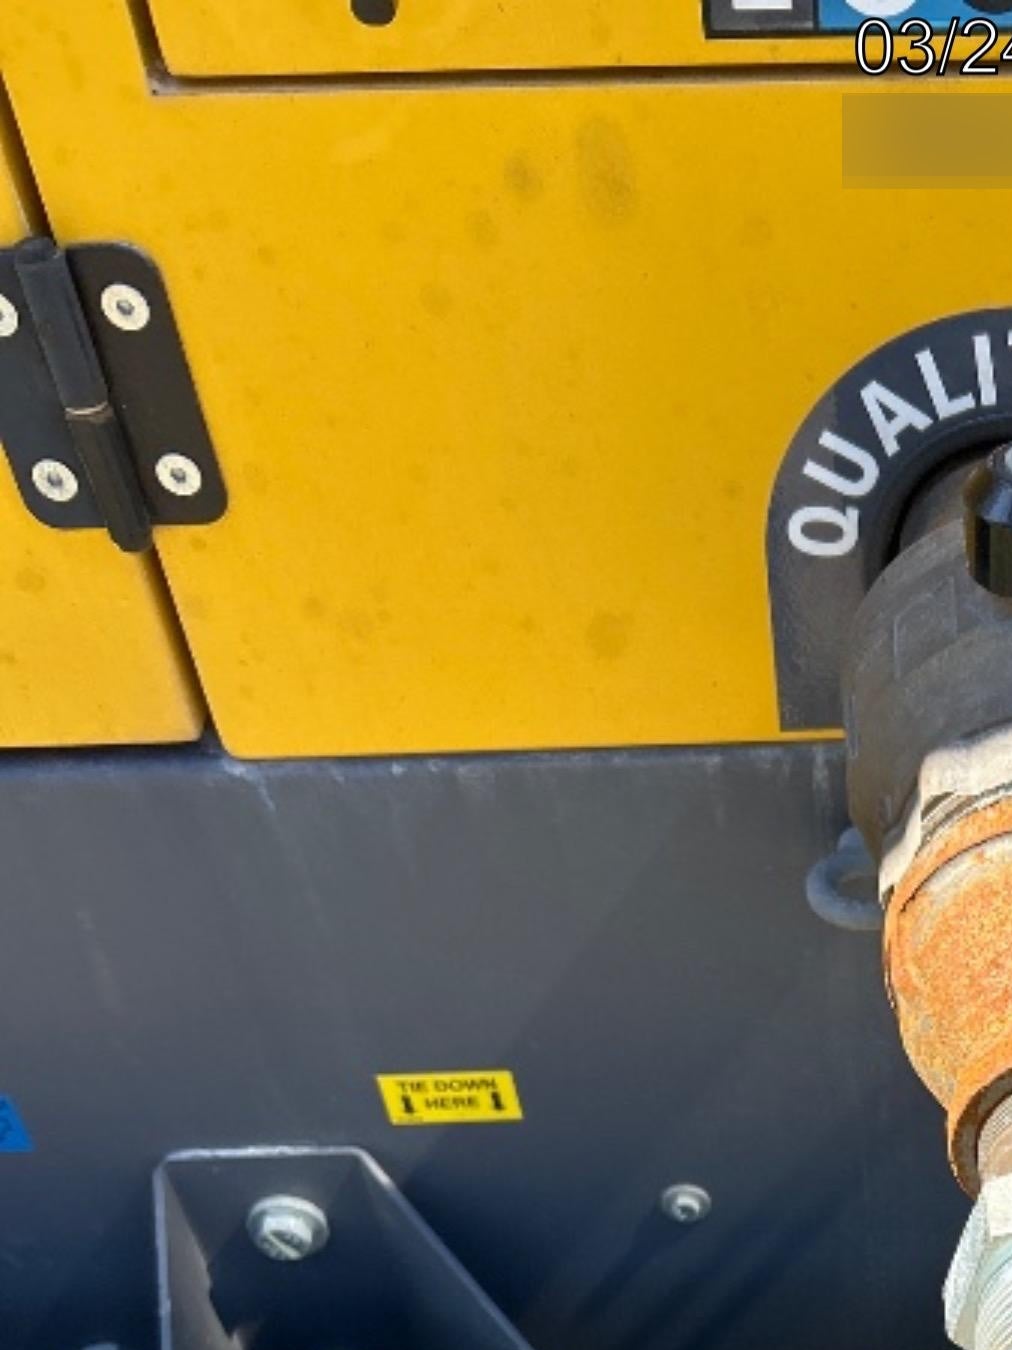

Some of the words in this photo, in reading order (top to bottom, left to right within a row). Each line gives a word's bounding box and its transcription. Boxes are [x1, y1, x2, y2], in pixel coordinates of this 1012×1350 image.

[397, 1080, 426, 1093] TIE
[434, 1077, 498, 1093] DOWN
[424, 1095, 478, 1110] HERE
